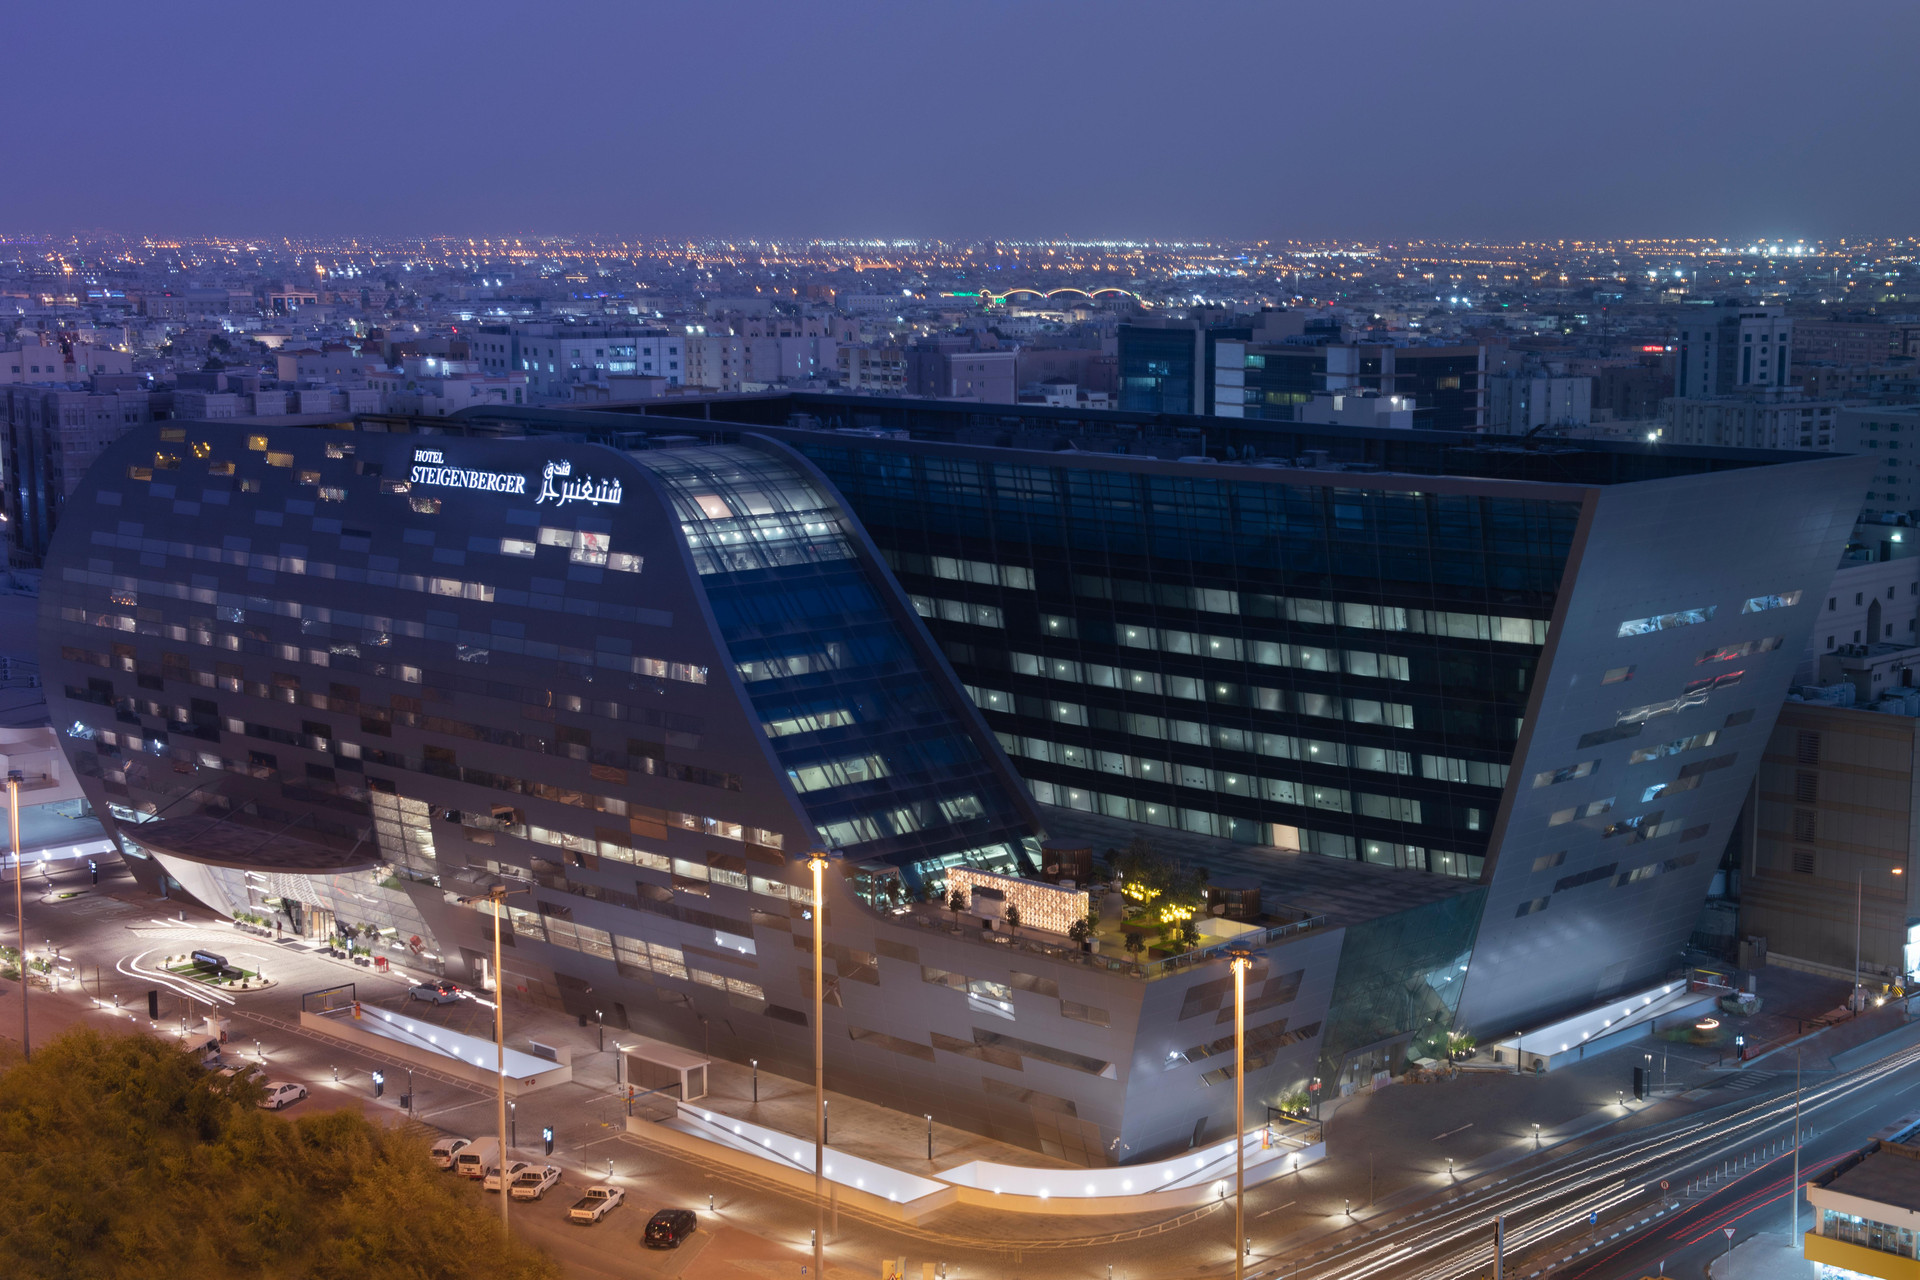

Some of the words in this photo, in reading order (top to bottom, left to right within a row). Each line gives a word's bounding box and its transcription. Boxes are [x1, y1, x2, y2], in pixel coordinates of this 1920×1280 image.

[414, 449, 444, 464] HOTEL
[410, 465, 526, 494] STEIGENBERGER
[544, 461, 571, 480] فندق
